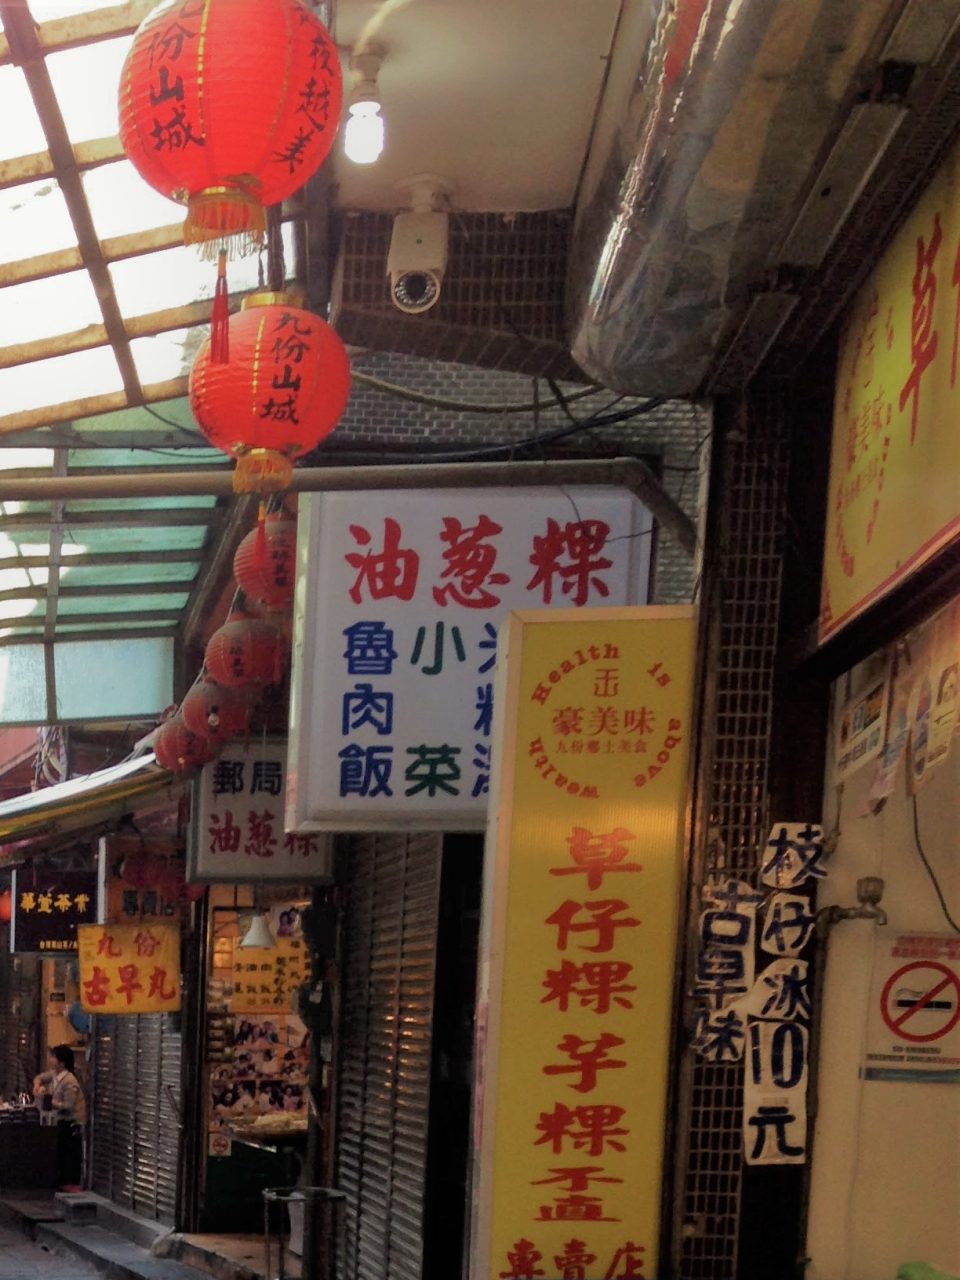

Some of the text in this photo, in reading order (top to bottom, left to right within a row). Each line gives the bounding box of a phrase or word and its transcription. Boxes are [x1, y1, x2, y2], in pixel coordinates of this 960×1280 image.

[259, 312, 312, 424] 九份山城
[897, 212, 960, 448] 草
[338, 621, 398, 797] 魯肉飯
[528, 643, 684, 799] Health is above wealth
[552, 705, 657, 737] 豪美味
[212, 760, 282, 796] 郵局
[98, 929, 161, 958] 九份
[83, 963, 177, 1007] 古早丸
